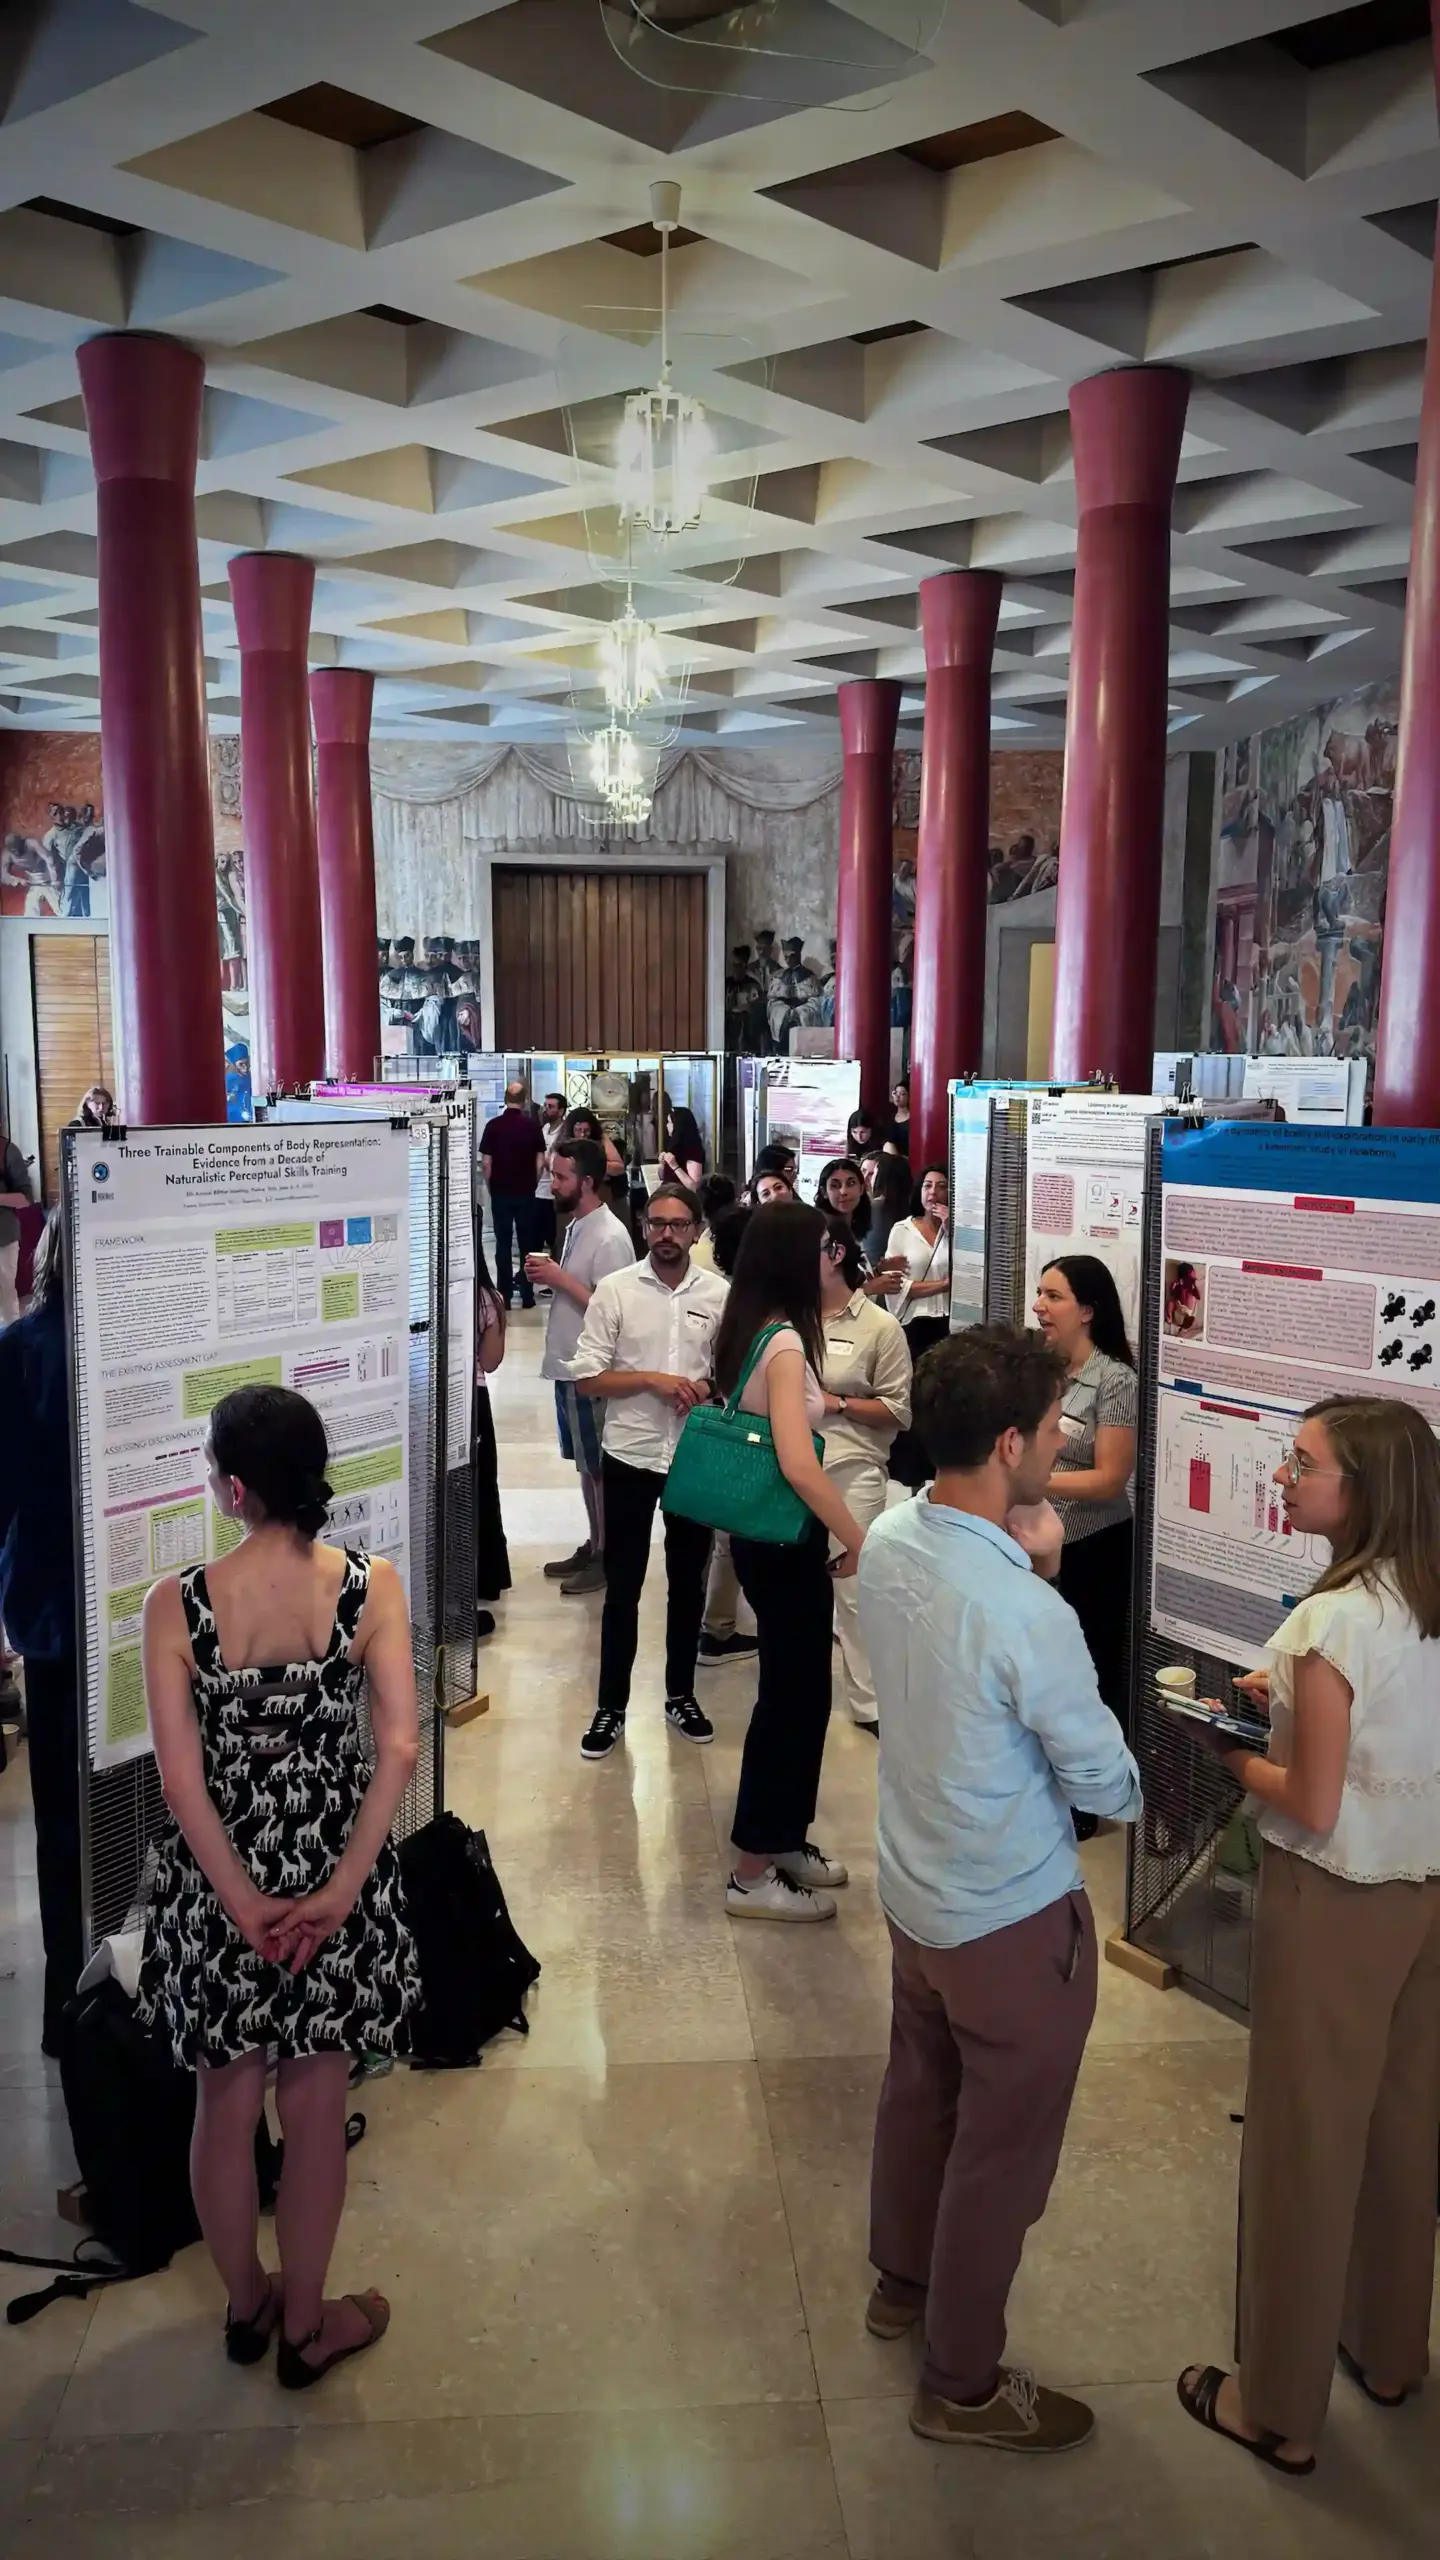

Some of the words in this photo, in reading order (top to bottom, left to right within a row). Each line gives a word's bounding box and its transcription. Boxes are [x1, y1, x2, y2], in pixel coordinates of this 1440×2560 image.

[414, 1128, 428, 1140] 38
[118, 1145, 151, 1158] Three
[154, 1143, 204, 1157] Trainable
[208, 1141, 271, 1156] Components
[274, 1139, 284, 1151] of
[287, 1138, 310, 1153] Body
[313, 1137, 381, 1151] Representation:
[193, 1157, 240, 1170] Evidence
[243, 1154, 266, 1167] from
[278, 1152, 313, 1165] Decade
[315, 1151, 325, 1163] of
[165, 1171, 226, 1185] Naturalistic
[229, 1167, 282, 1182] Perceptual
[284, 1166, 309, 1177] Skills
[312, 1164, 347, 1176] Training
[95, 1235, 146, 1249] FRAMEWORK
[102, 1370, 115, 1379] THE
[118, 1363, 153, 1377] EXISTING
[155, 1355, 201, 1370] ASSESSMENT
[104, 1441, 148, 1456] ASSESSING
[148, 1427, 205, 1447] DISCRIMINATIVE
